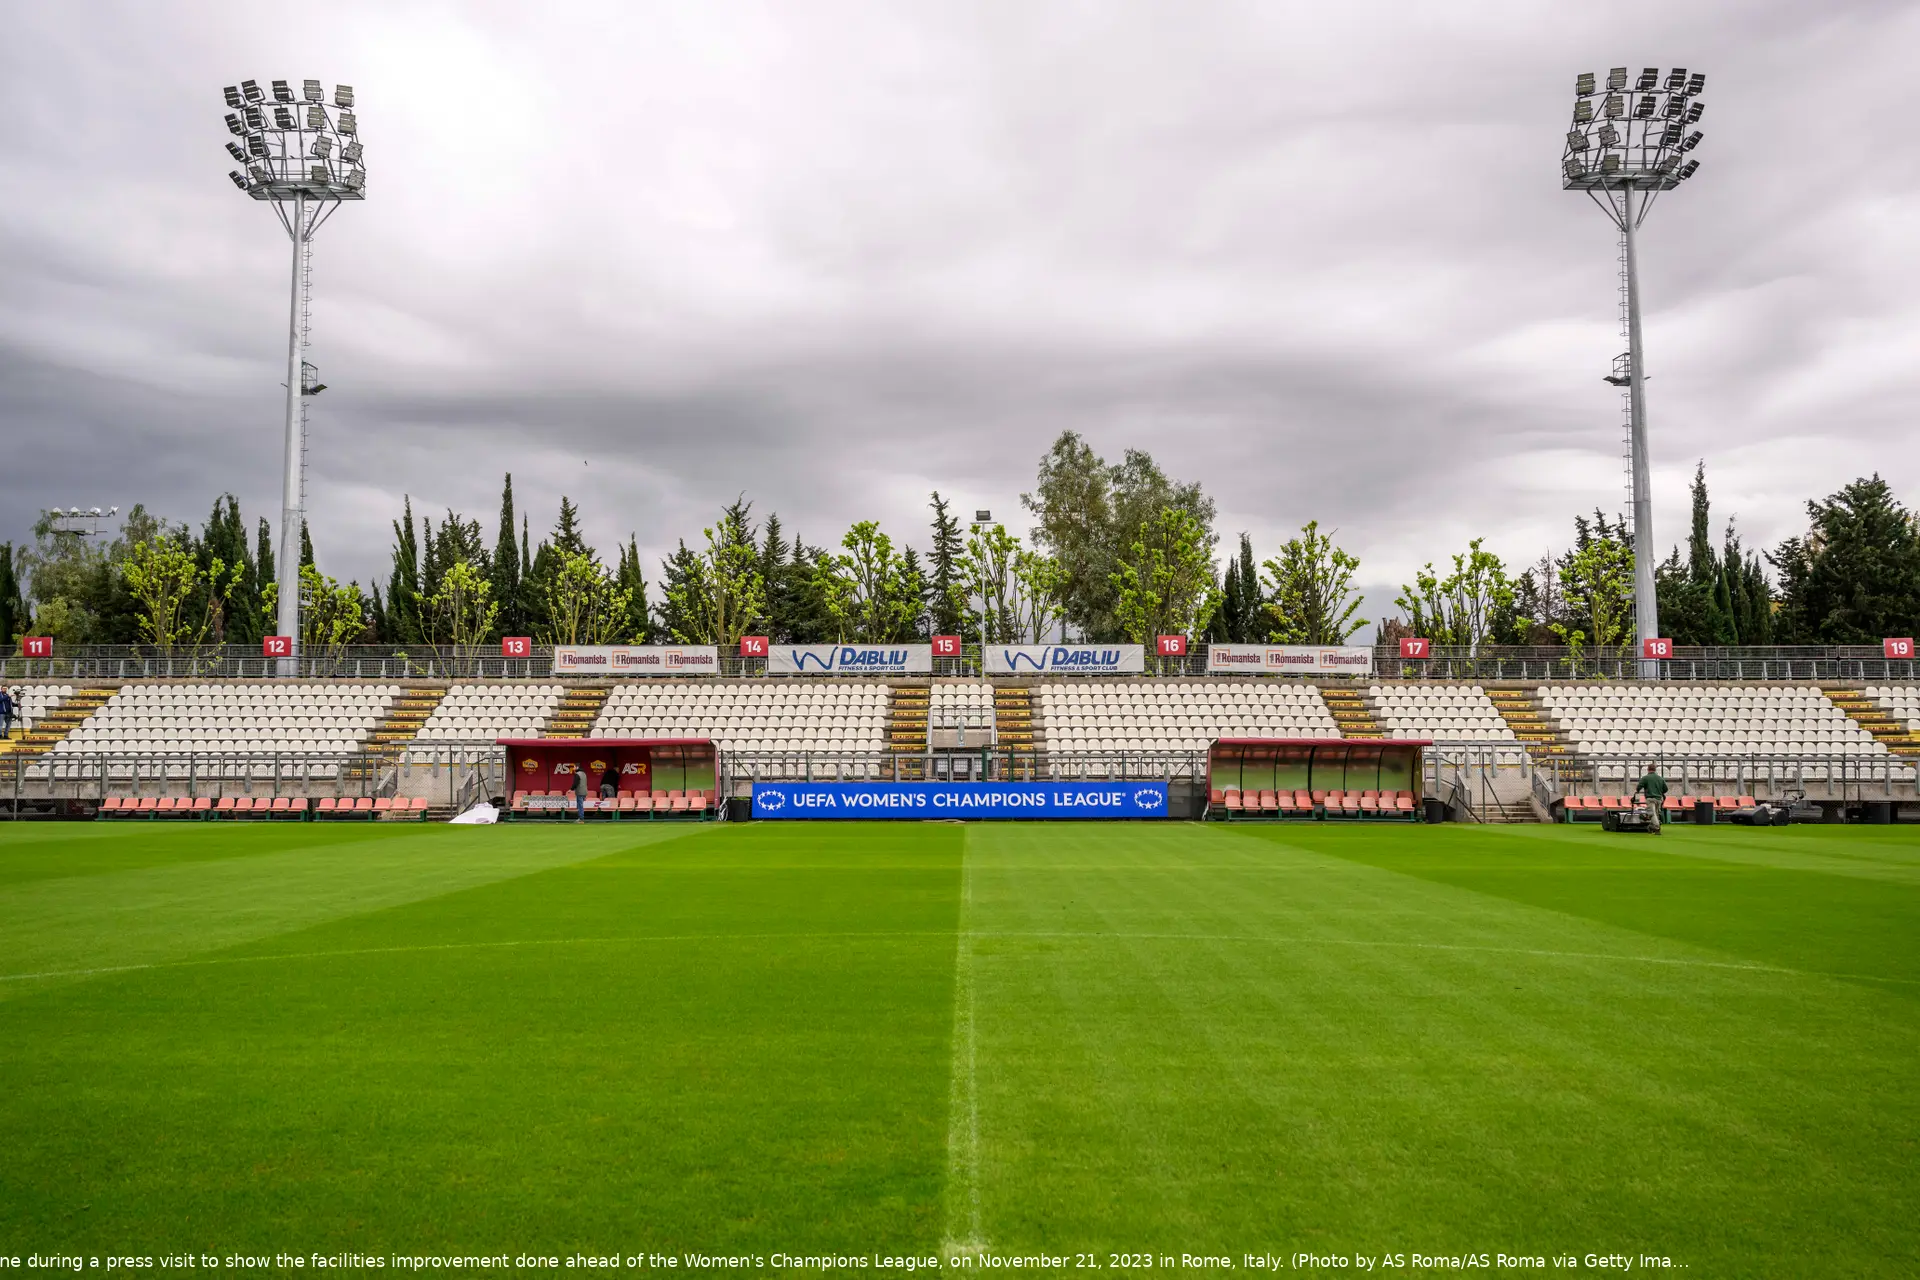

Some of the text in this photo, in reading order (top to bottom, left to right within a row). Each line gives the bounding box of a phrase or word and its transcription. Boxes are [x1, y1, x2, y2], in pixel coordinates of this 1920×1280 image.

[29, 641, 43, 653] 11
[269, 641, 284, 653] 12
[507, 641, 523, 653] 13
[745, 641, 761, 653] 14
[937, 640, 953, 652] 15
[1163, 640, 1179, 652] 16
[1407, 643, 1422, 654] 17
[1650, 643, 1666, 654] 18
[1891, 642, 1907, 654] 19
[568, 655, 606, 664] Romanista
[621, 655, 659, 664] Romanista
[674, 655, 713, 664] Romanista
[840, 648, 908, 665] DABLIU
[1052, 648, 1120, 665] DABLIU
[1222, 653, 1261, 663] Romanista
[1275, 654, 1314, 664] Romanista
[1329, 655, 1368, 664] Romanista
[622, 763, 646, 774] ASR
[794, 793, 836, 807] UEFA
[842, 793, 926, 807] WOMEN'S
[933, 793, 1045, 807] CHAMPIONS
